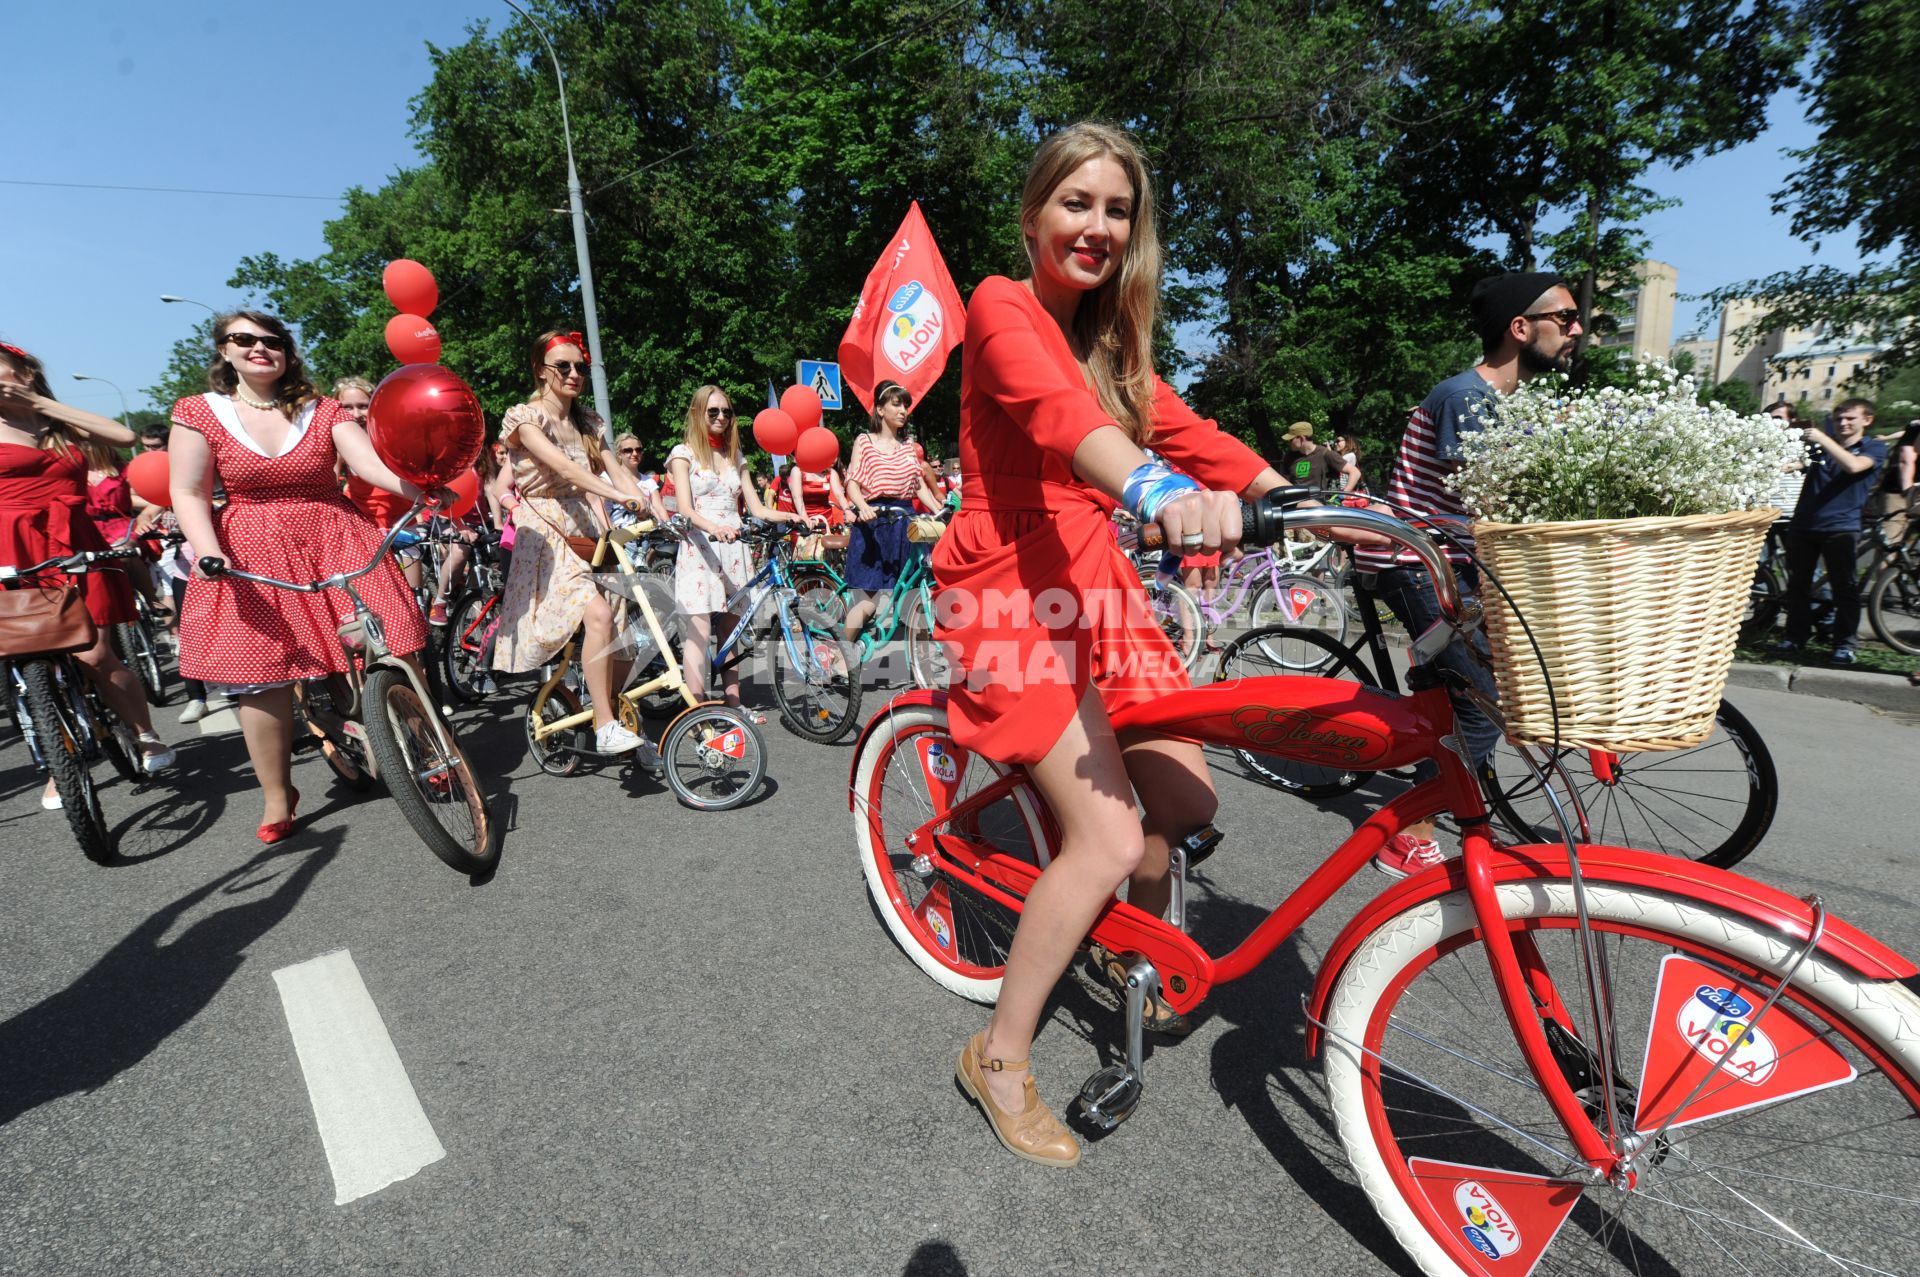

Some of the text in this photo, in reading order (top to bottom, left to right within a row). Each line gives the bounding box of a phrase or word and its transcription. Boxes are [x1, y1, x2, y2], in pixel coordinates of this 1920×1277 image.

[1232, 705, 1368, 751] Electra
[1700, 988, 1742, 1016] Valio
[1687, 1020, 1757, 1079] VIOLA
[1469, 1186, 1516, 1242] VIOLA
[1469, 1228, 1498, 1258] Valio
